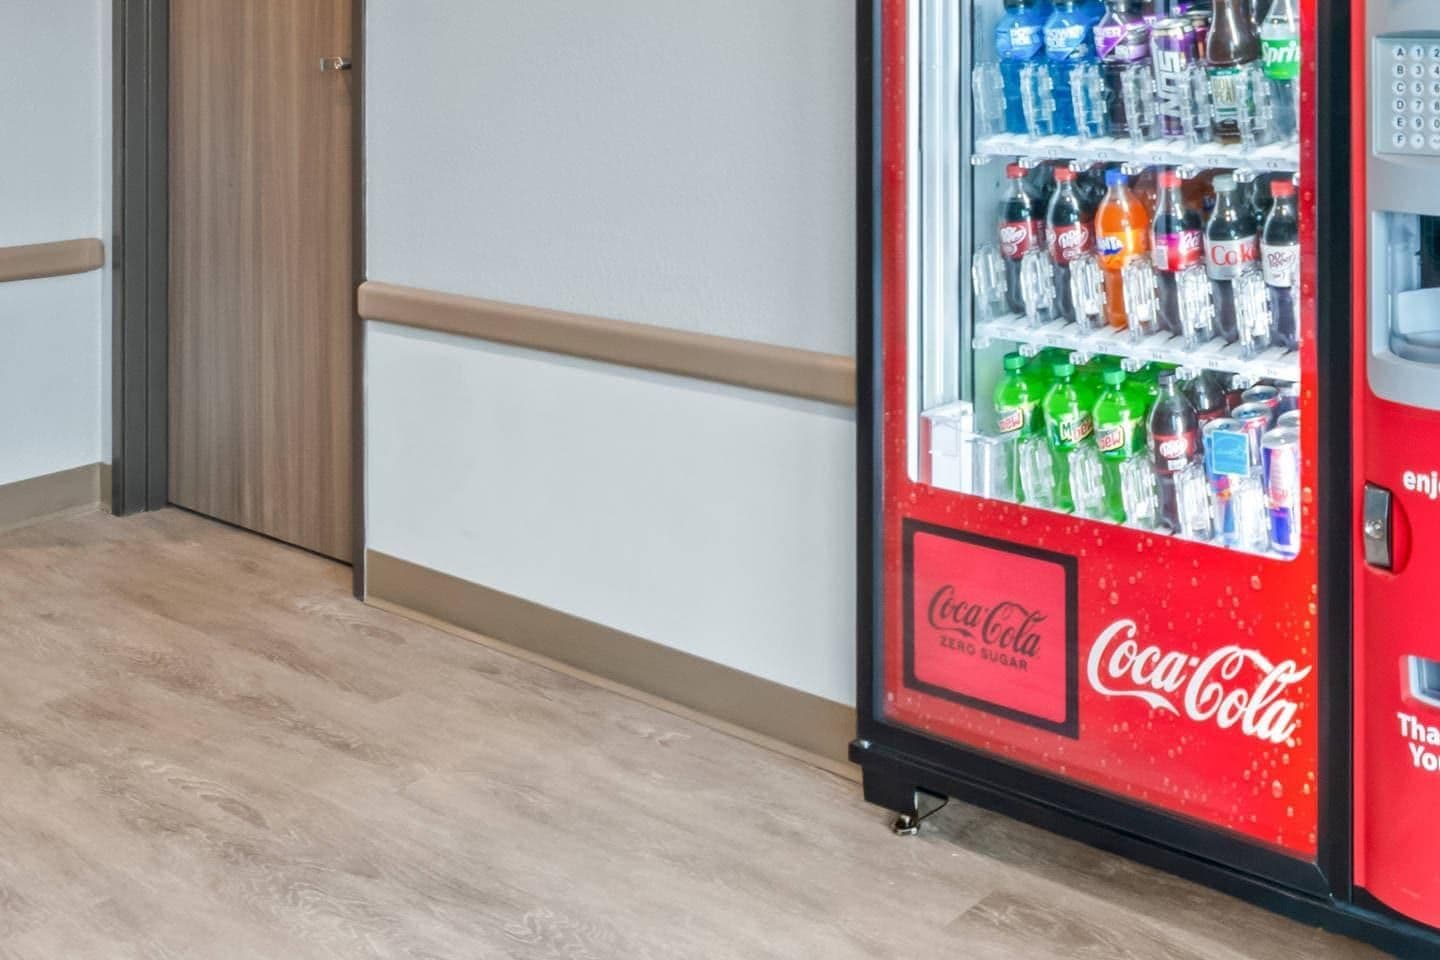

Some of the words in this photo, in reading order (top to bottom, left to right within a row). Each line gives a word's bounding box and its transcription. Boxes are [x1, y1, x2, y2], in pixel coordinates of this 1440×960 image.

[1396, 47, 1404, 57] A
[1433, 48, 1440, 58] 2
[1396, 65, 1404, 75] B
[1415, 65, 1421, 75] 3
[1433, 66, 1440, 75] 4
[1396, 82, 1404, 92] C
[1415, 83, 1421, 93] 5
[1434, 83, 1440, 93] 6
[1396, 100, 1404, 110] D
[1415, 100, 1421, 110] 7
[1434, 101, 1440, 111] 8
[1397, 117, 1403, 127] E
[1415, 118, 1421, 128] 9
[1433, 119, 1440, 129] 0
[1397, 134, 1403, 144] F
[927, 584, 1048, 658] Coca-Cola
[939, 635, 976, 657] ZERO
[979, 647, 1029, 672] SUGAR
[1086, 619, 1313, 747] Coca-Cola
